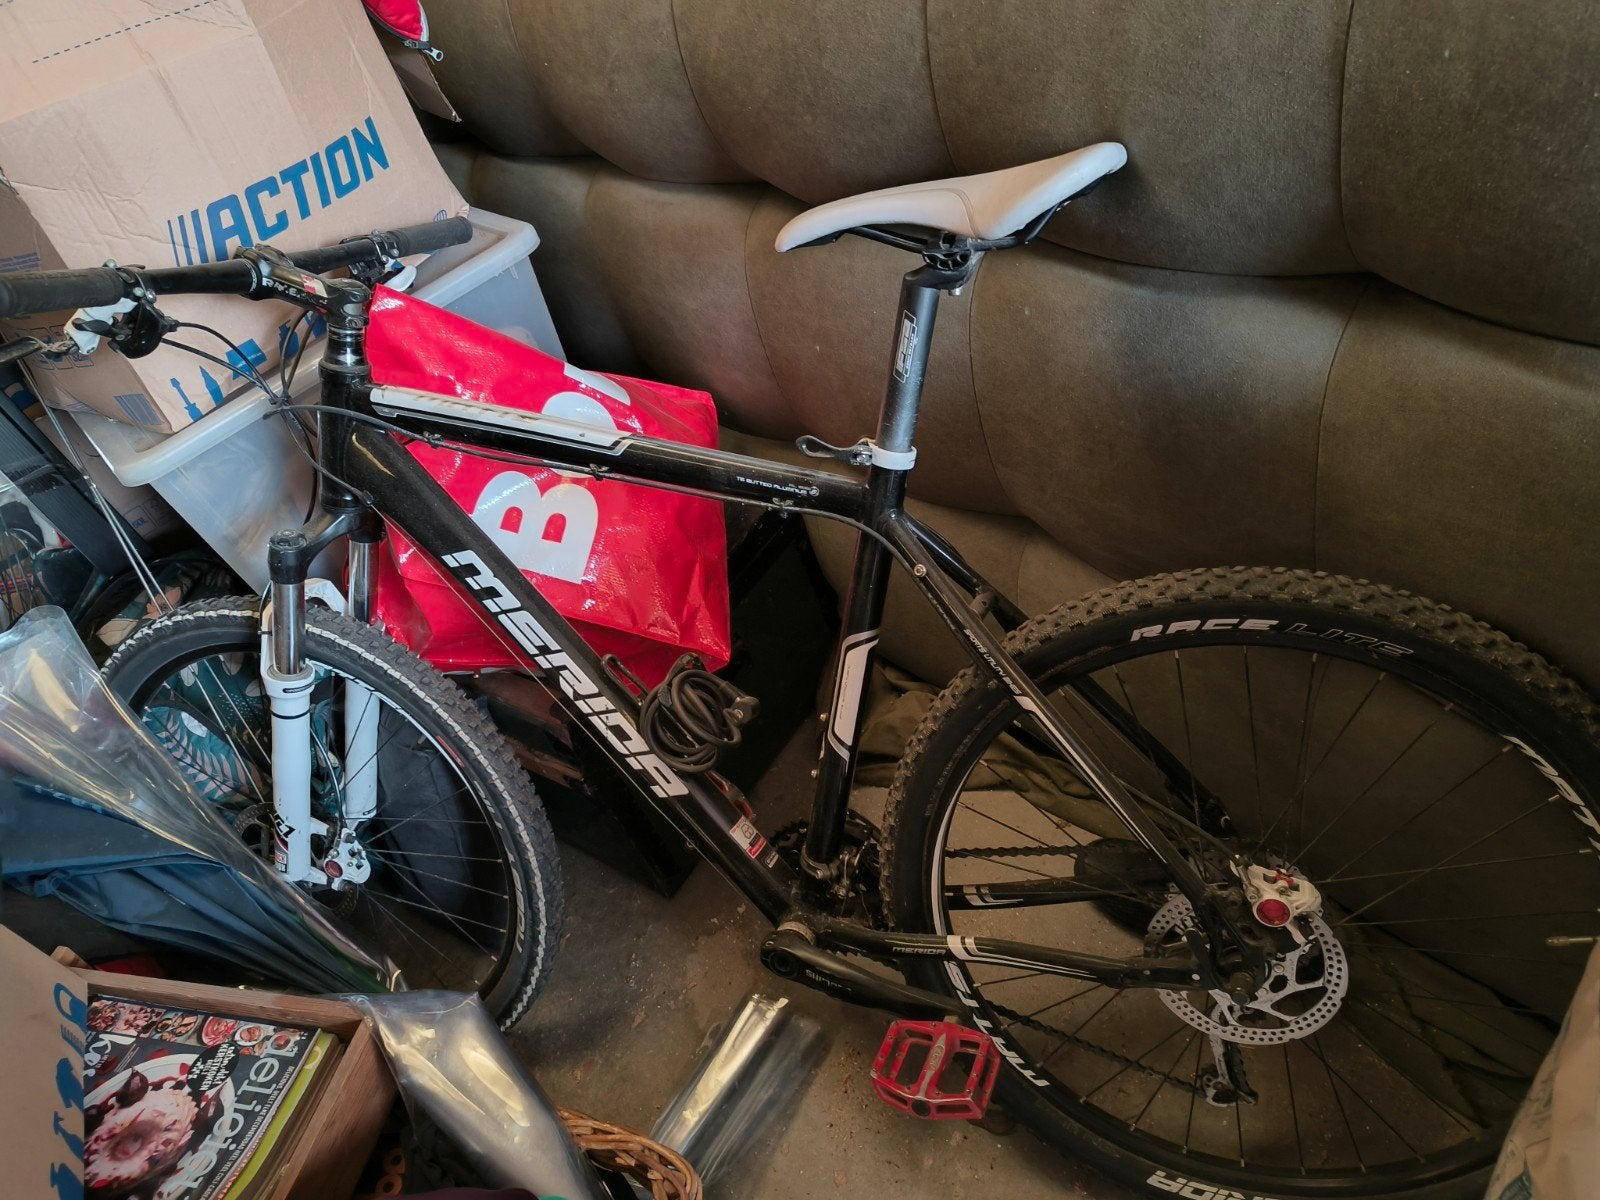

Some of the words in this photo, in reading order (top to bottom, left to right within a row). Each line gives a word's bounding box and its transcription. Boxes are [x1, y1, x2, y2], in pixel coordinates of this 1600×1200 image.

[206, 115, 390, 261] ACTION
[441, 549, 690, 799] MERIDA
[1130, 618, 1280, 642] RACE
[1284, 622, 1415, 657] LITE
[892, 946, 947, 956] MERIDA
